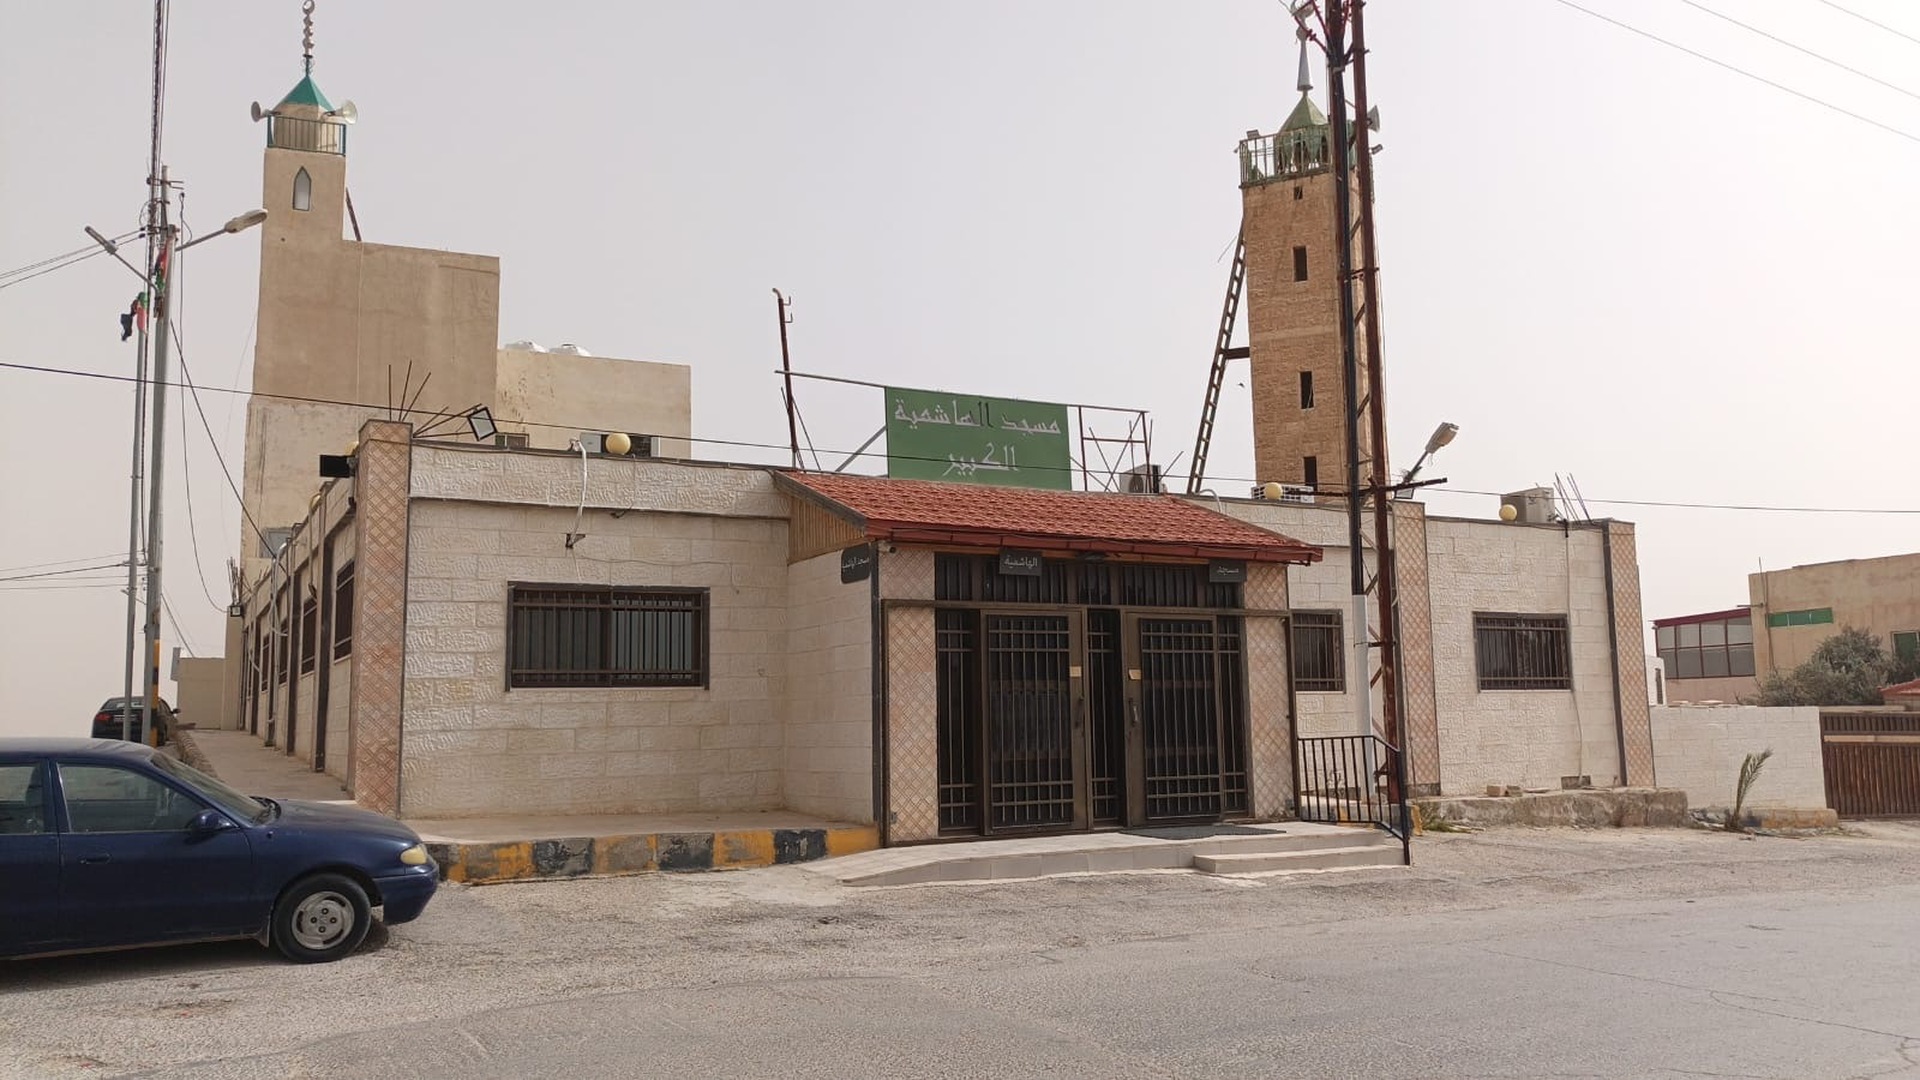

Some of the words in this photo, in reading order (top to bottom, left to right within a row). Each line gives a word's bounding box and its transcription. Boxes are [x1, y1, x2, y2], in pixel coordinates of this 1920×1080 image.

[895, 398, 994, 430] الهاشمية
[1001, 412, 1061, 436] مسجد
[942, 442, 1020, 476] الكبير
